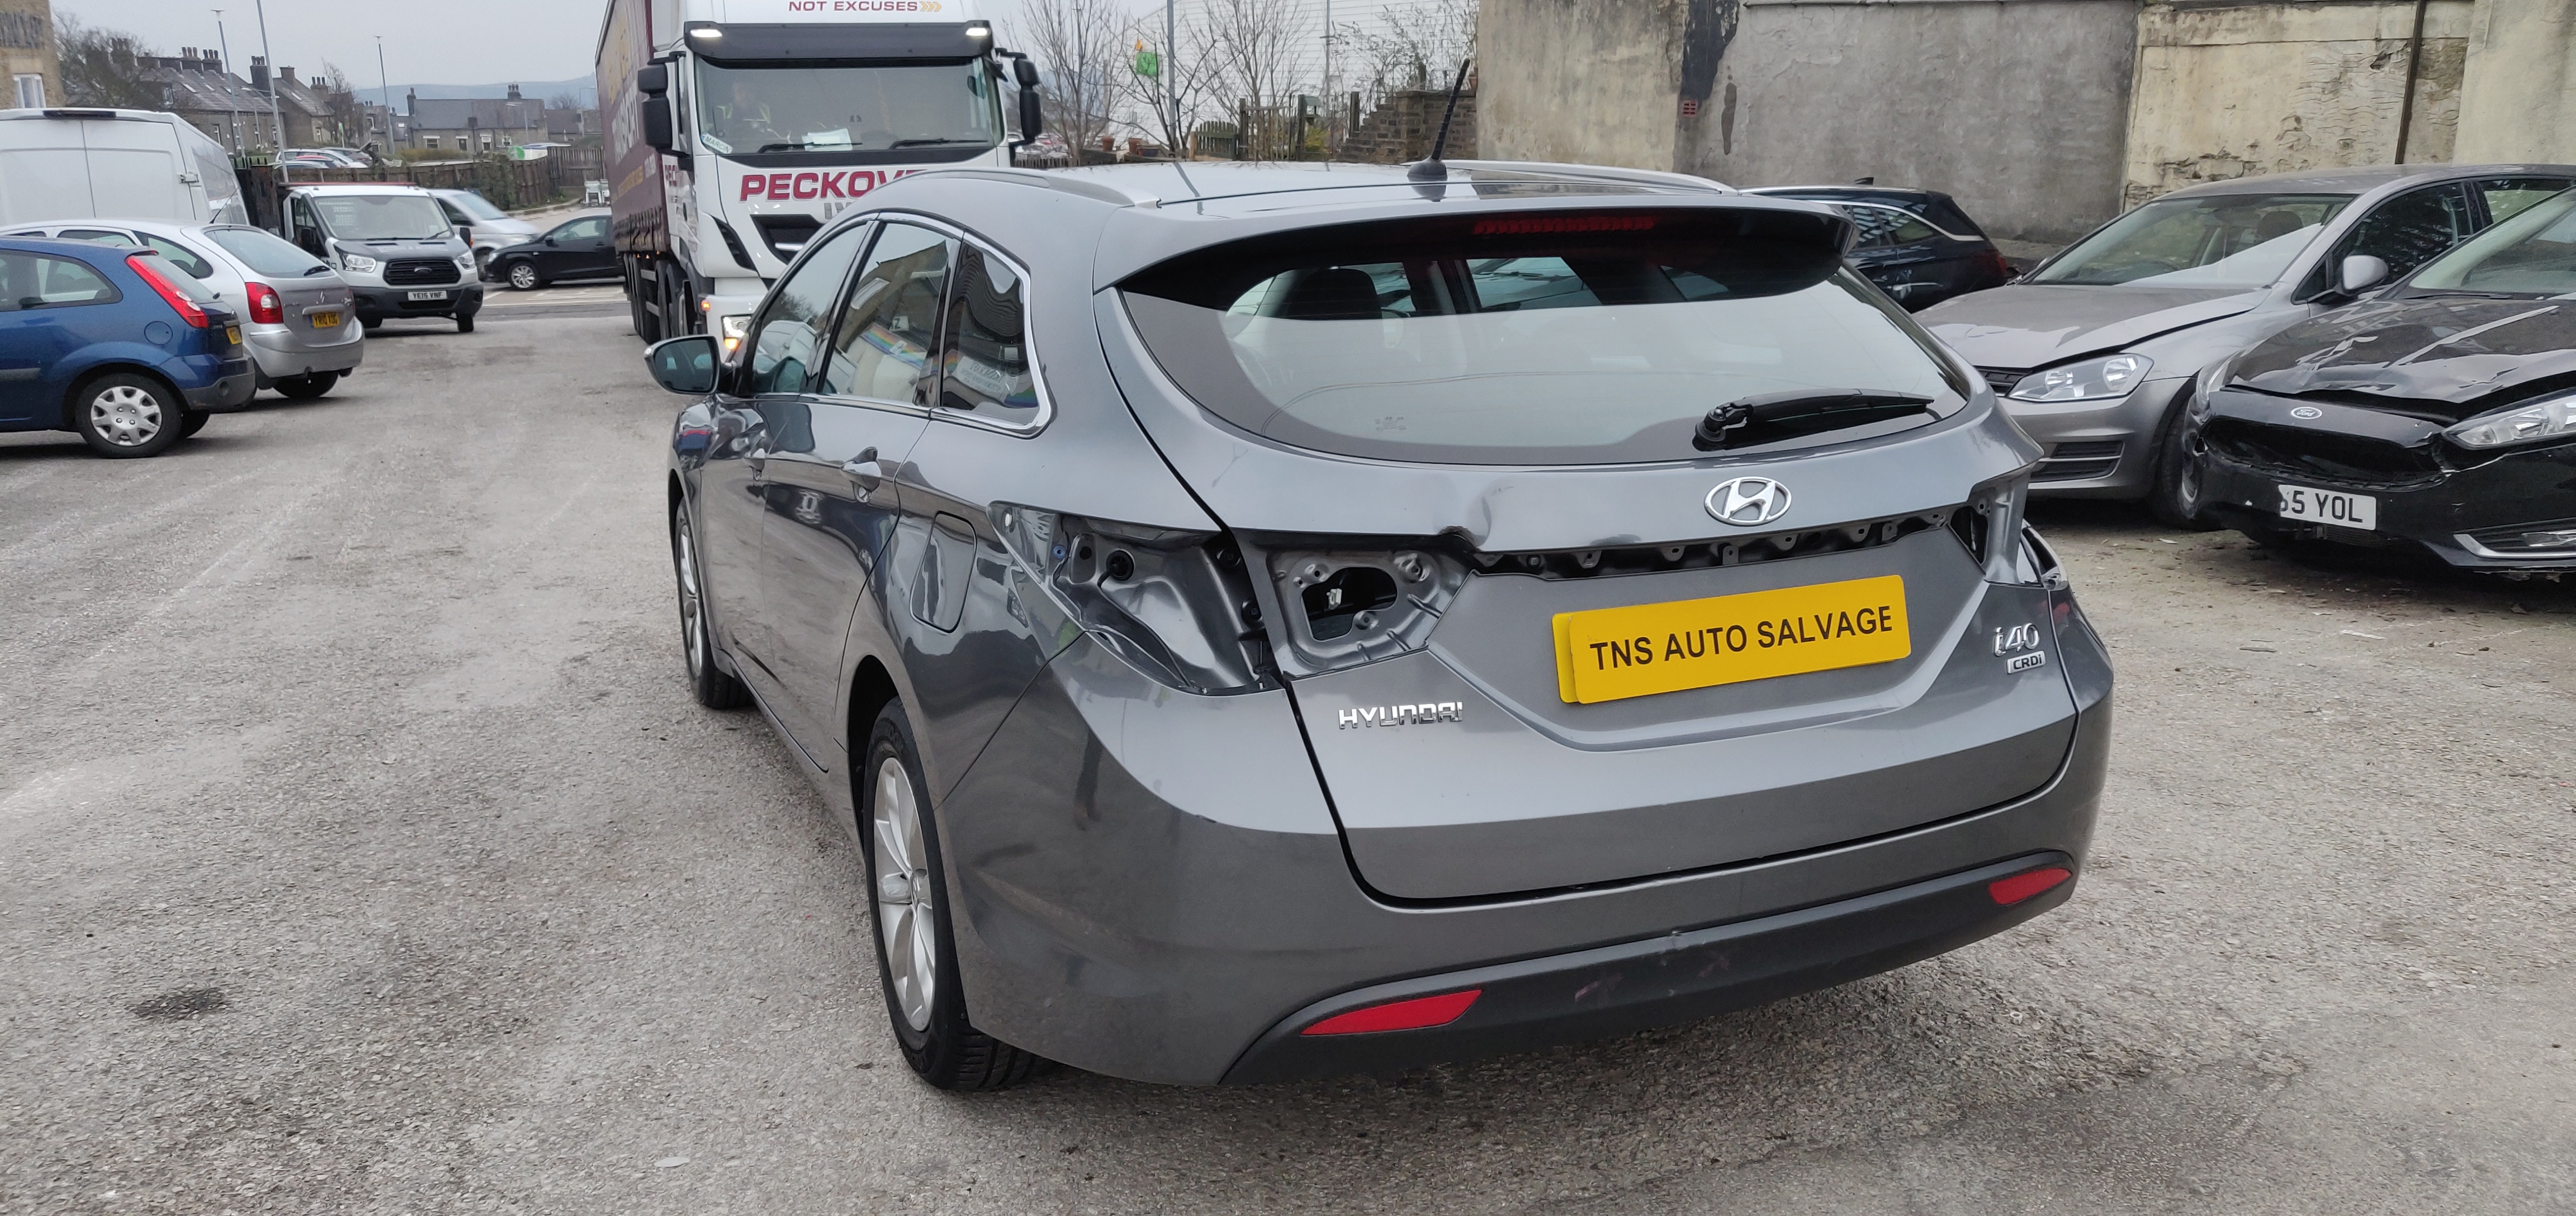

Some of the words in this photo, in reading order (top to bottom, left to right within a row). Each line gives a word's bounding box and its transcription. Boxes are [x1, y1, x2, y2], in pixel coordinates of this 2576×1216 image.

[789, 1, 827, 11] NOT
[834, 1, 918, 11] EXCUSES
[704, 136, 731, 153] MARCIN
[2315, 492, 2363, 523] YOL
[1590, 636, 1653, 670] TNS
[1664, 625, 1747, 662] AUTO
[1757, 605, 1892, 648] SALVAGE
[1993, 623, 2040, 657] i40
[2013, 654, 2042, 669] CRDi
[1339, 702, 1463, 729] HYUNDAI
